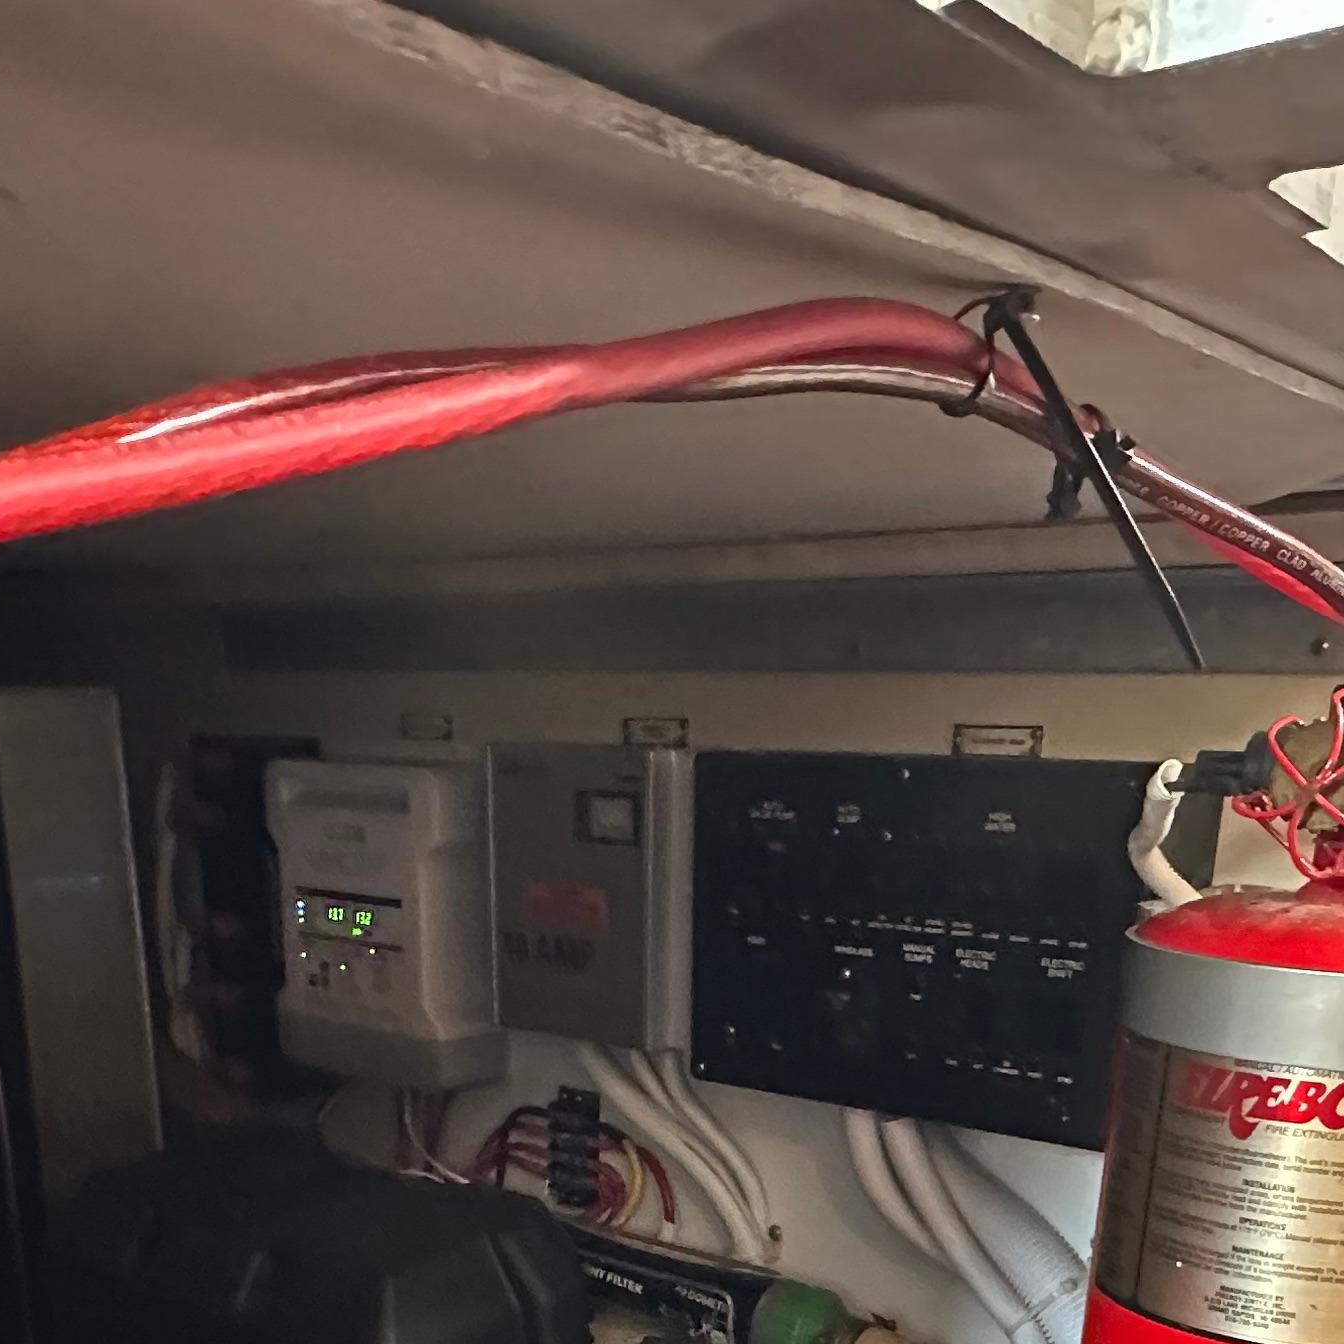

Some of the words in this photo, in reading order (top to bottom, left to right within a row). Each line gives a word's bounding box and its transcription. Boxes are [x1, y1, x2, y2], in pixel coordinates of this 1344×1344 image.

[1275, 547, 1307, 572] CLAD
[1041, 957, 1085, 971] ELECTRIC
[1264, 1124, 1289, 1136] FIRE
[1242, 1179, 1296, 1193] INSTALLATION
[1232, 1245, 1284, 1260] MAINTENANCE
[605, 1272, 644, 1295] FILTER
